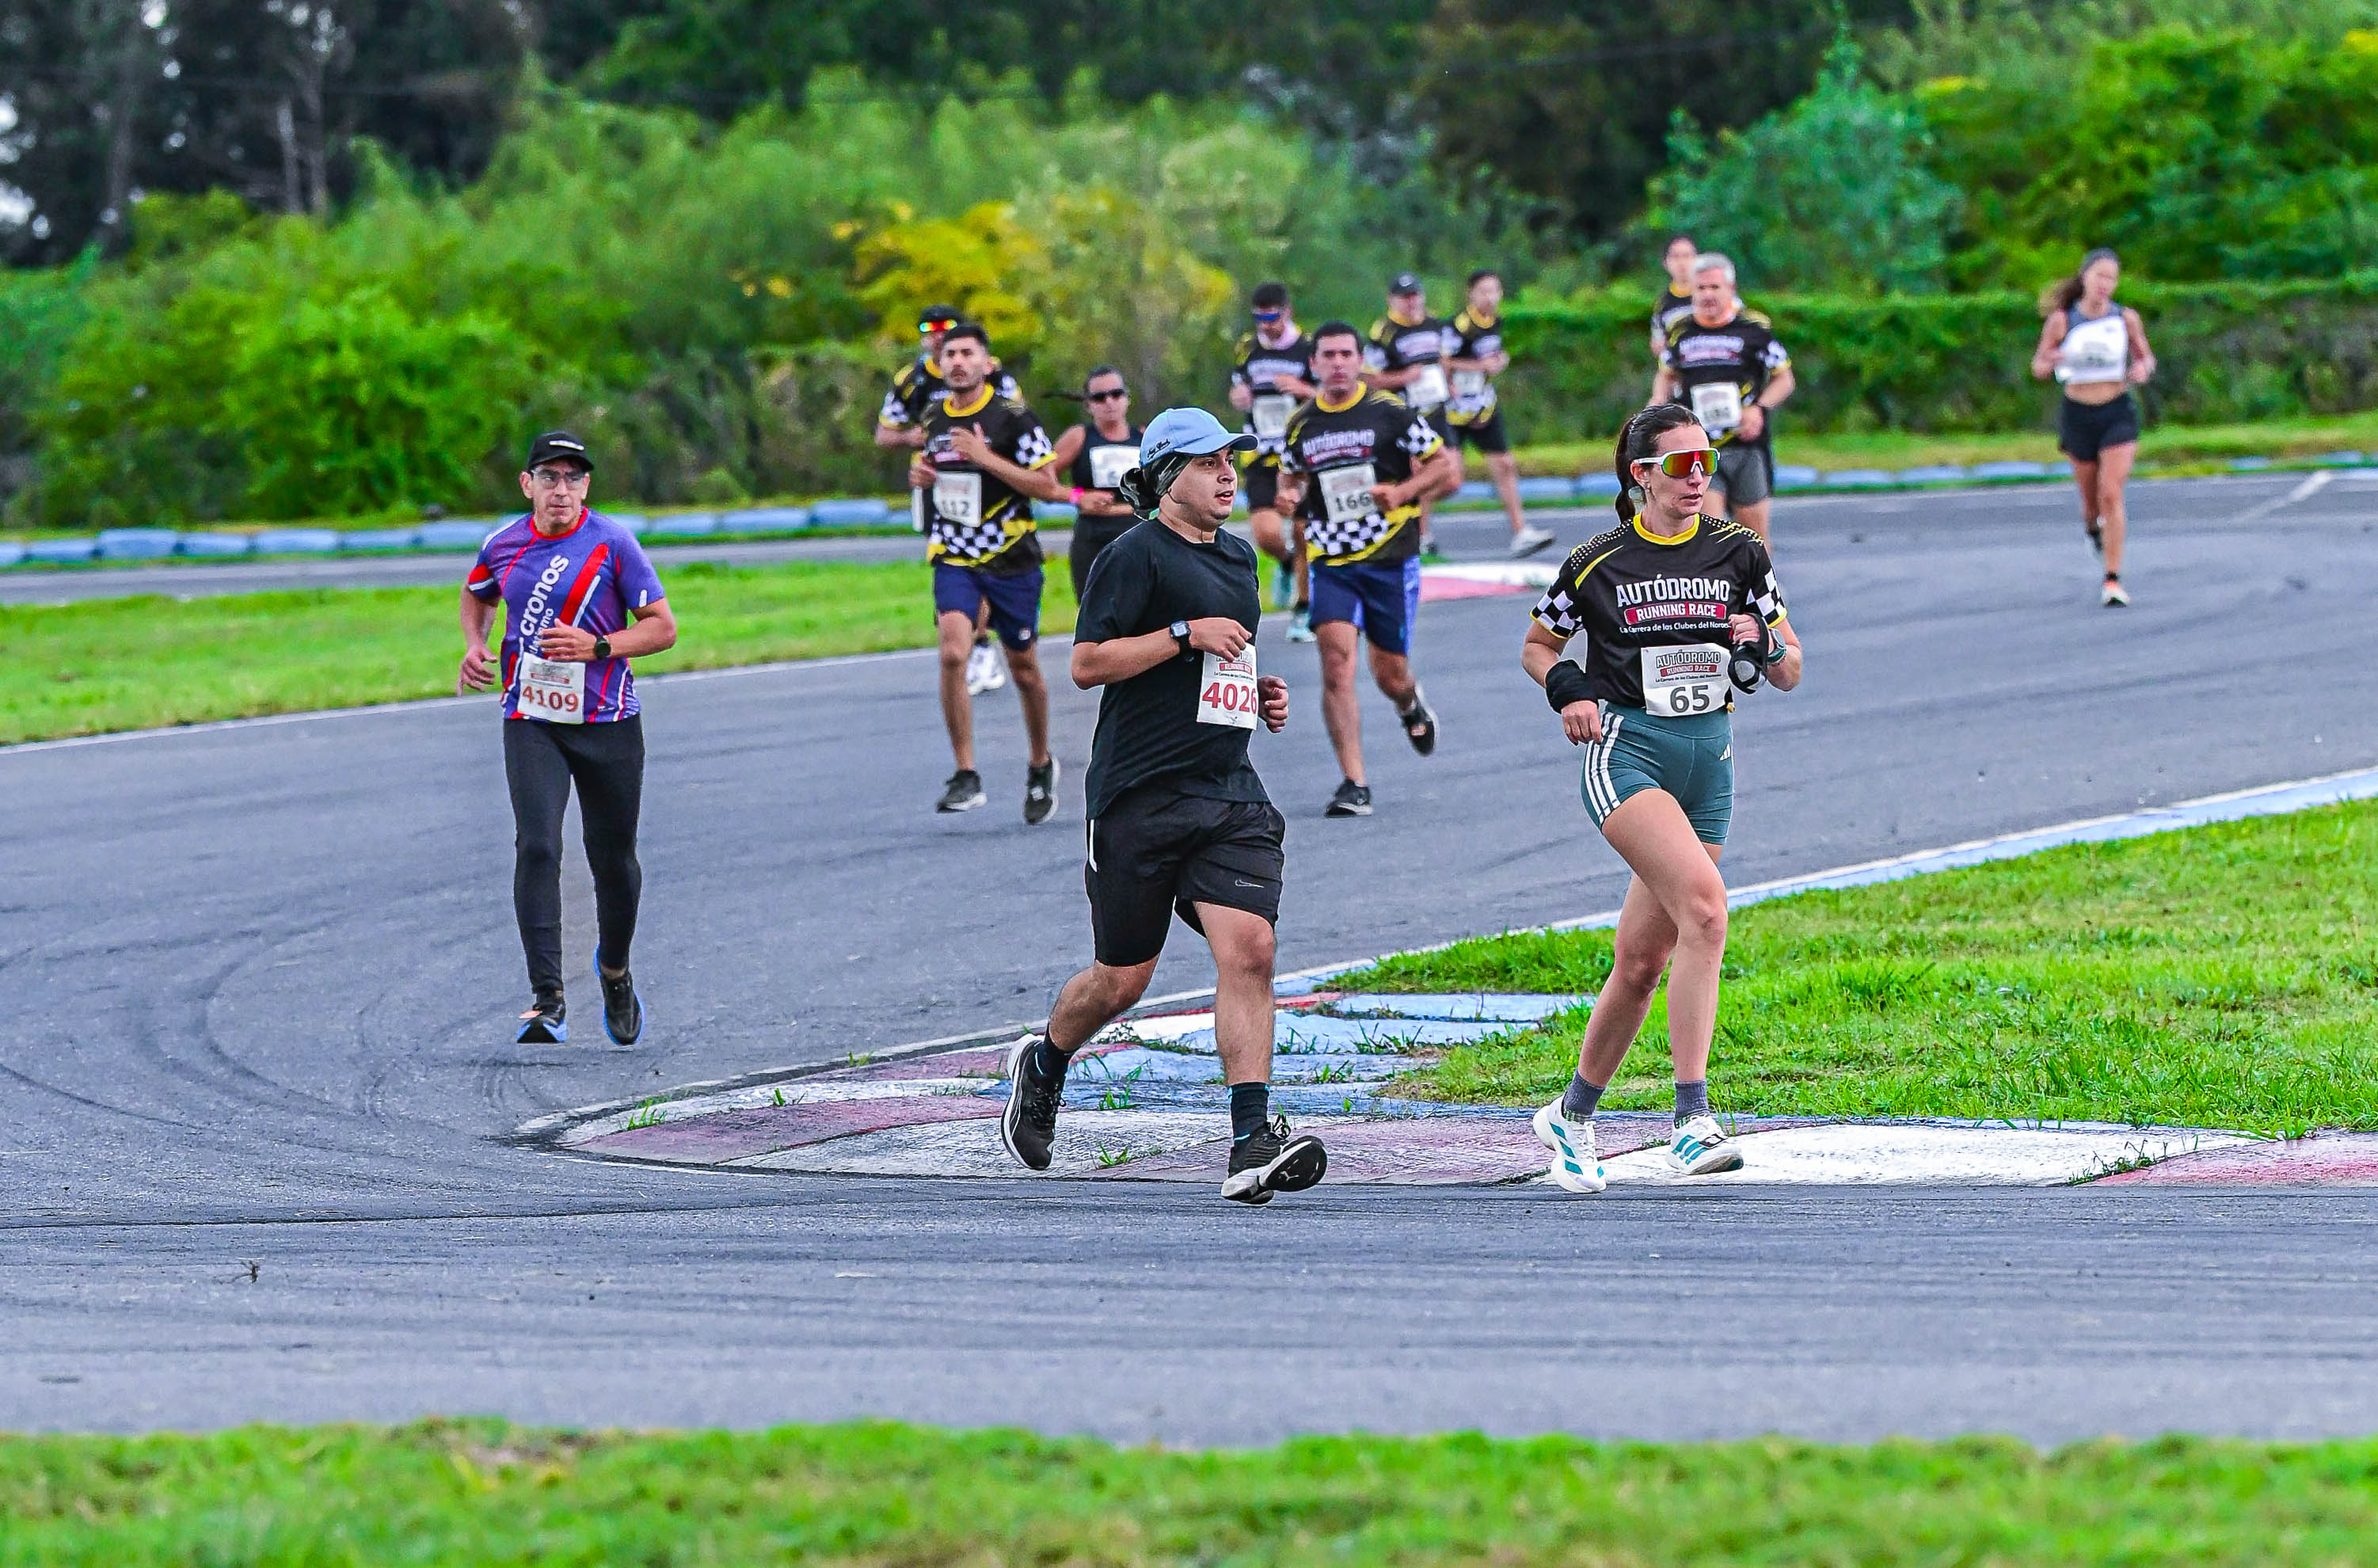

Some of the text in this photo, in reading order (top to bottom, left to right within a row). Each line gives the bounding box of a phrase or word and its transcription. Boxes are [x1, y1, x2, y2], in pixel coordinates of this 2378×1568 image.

[519, 554, 569, 637] cronos
[1615, 573, 1730, 607] AUTÓDROMO
[1636, 603, 1717, 622] RUNNING RACE
[1656, 649, 1722, 668] AUTÓDROMO
[522, 685, 579, 712] 4109
[1202, 682, 1257, 714] 4026
[1670, 685, 1710, 713] 65
